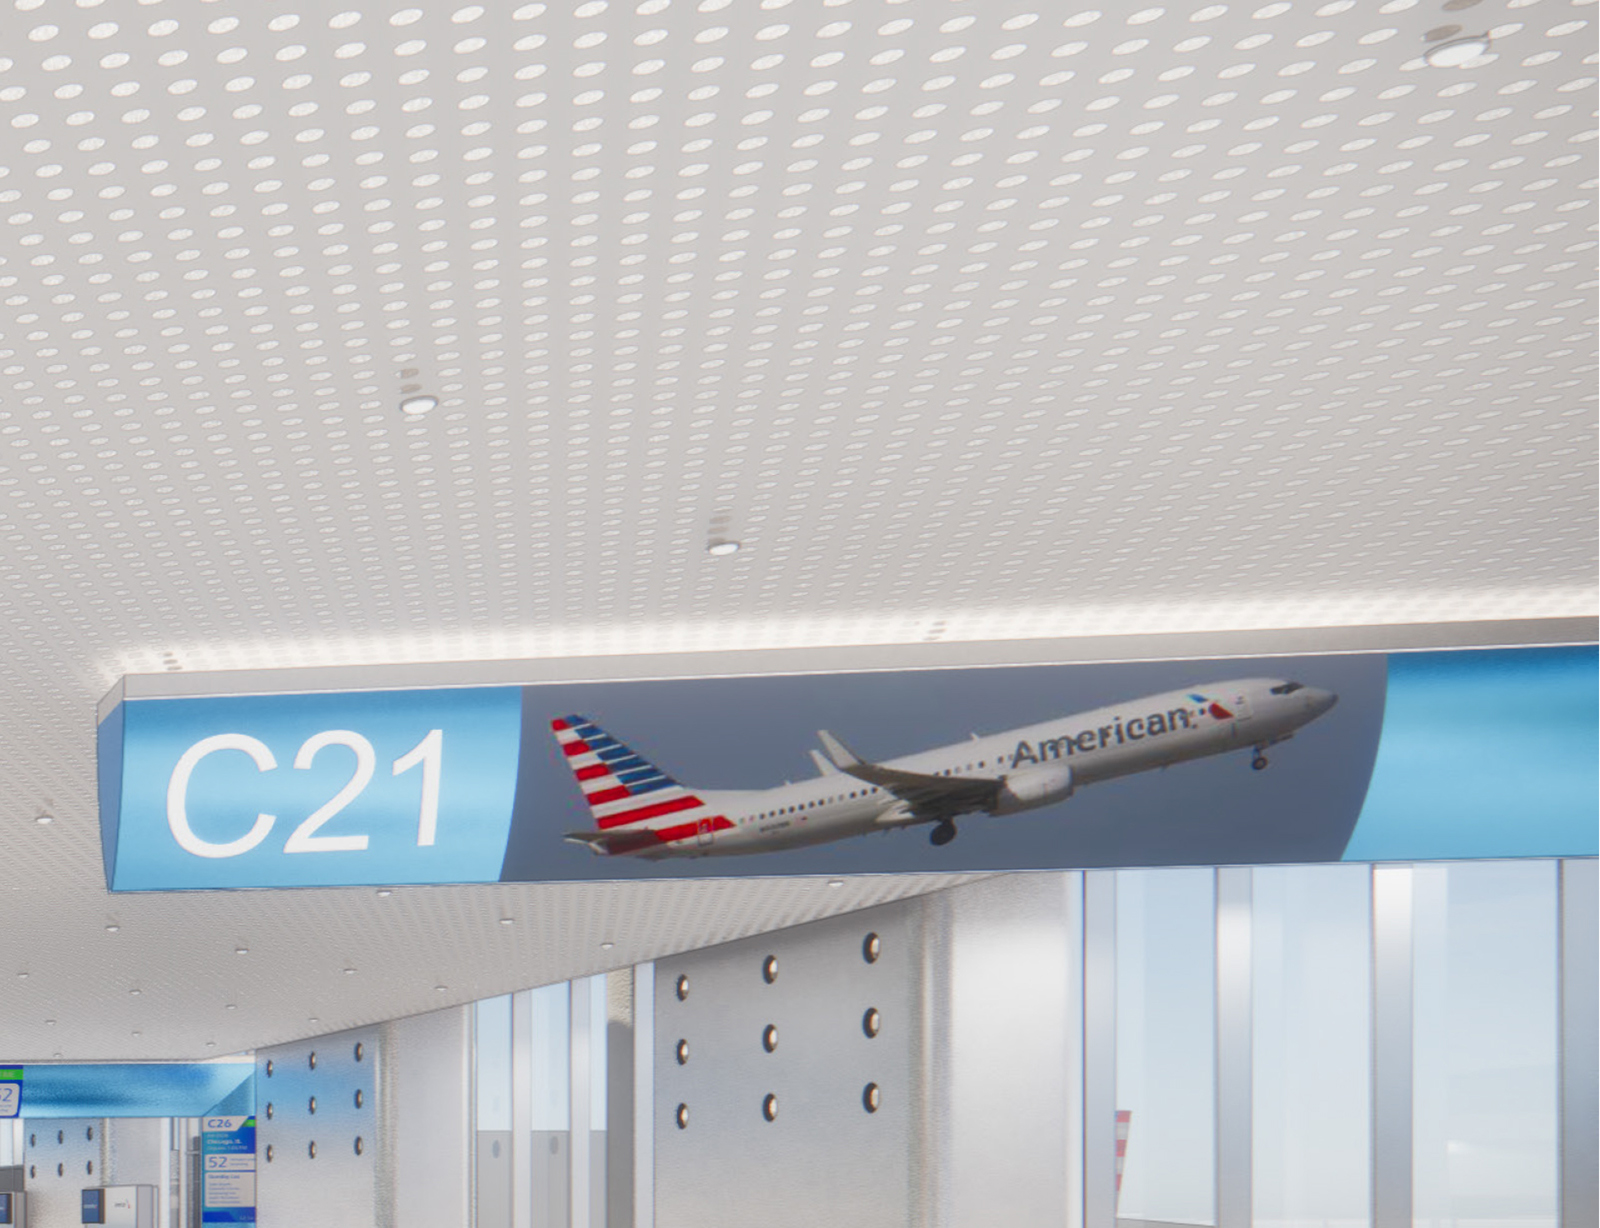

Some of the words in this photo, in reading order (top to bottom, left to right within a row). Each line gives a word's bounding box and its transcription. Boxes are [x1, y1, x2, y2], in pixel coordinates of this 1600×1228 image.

[1010, 707, 1195, 769] American
[166, 729, 444, 858] C21
[207, 1119, 232, 1128] C26
[208, 1156, 228, 1168] 52
